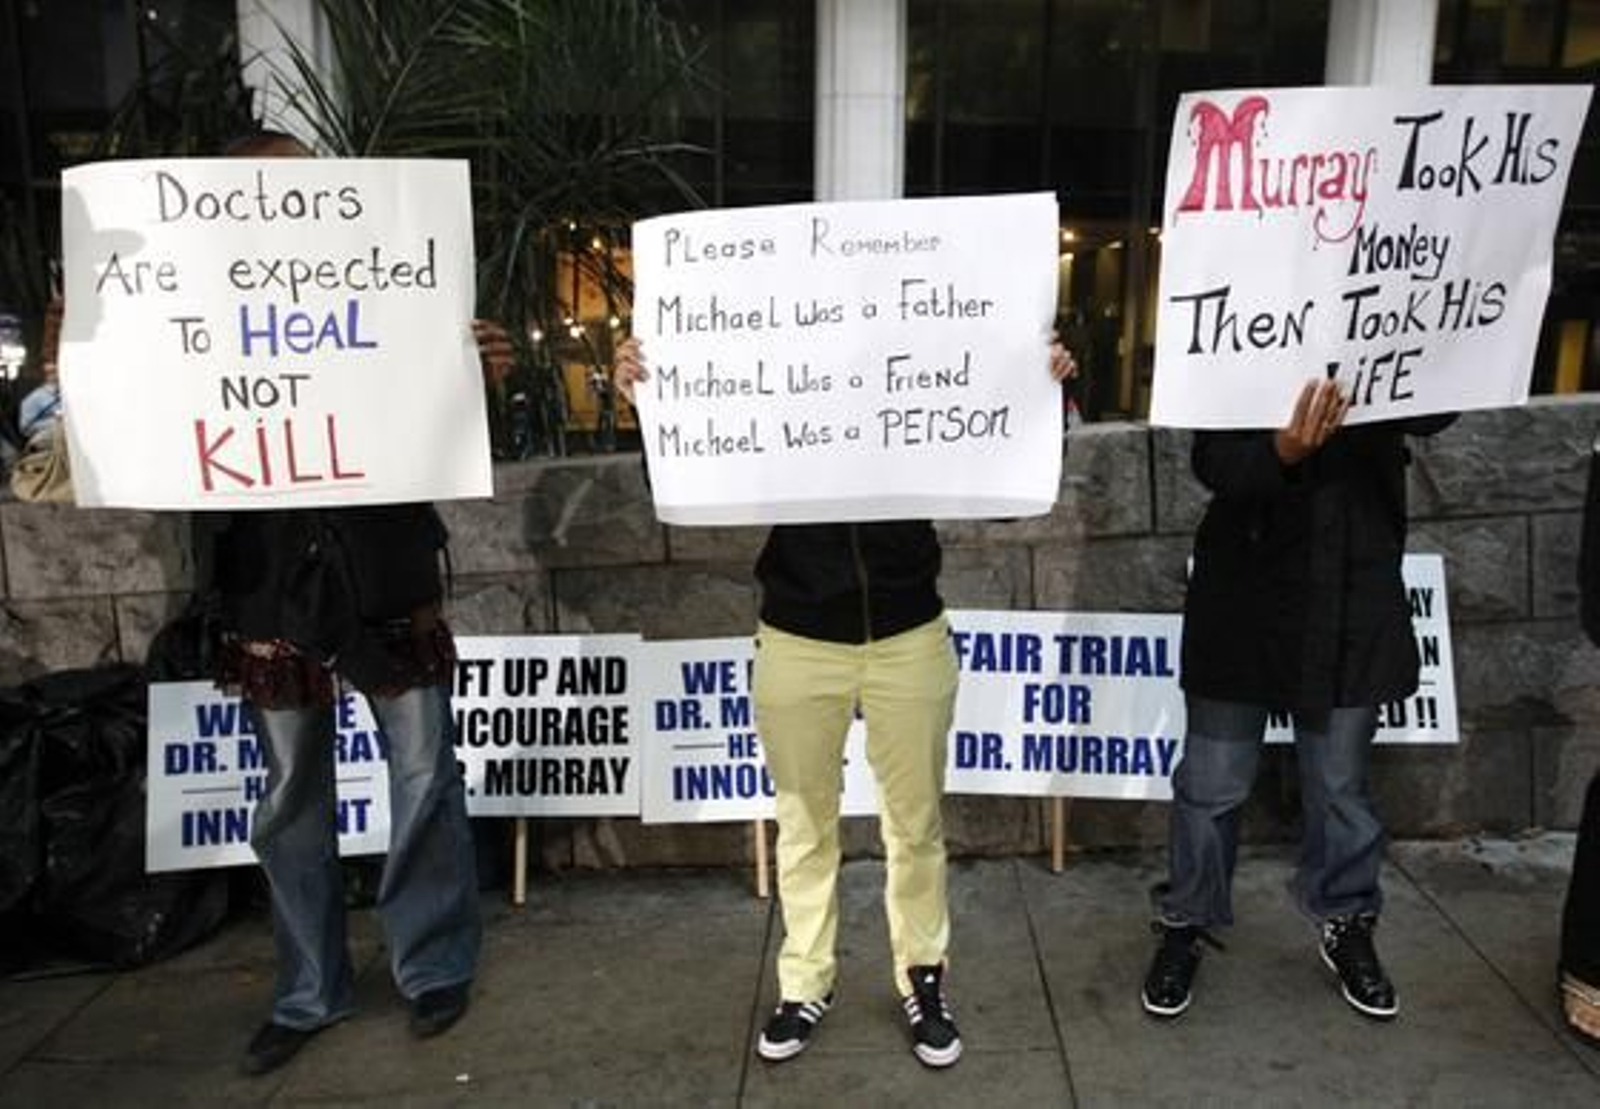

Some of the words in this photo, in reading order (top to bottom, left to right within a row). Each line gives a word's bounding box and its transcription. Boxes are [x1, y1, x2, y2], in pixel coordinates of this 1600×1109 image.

[1174, 94, 1378, 242] Murray
[1395, 110, 1489, 196] Took
[156, 170, 363, 223] Doctors
[811, 216, 943, 257] Remember
[97, 253, 179, 295] Are
[228, 239, 437, 302] expected
[863, 302, 878, 320] a
[900, 279, 994, 320] Father
[170, 317, 211, 354] To
[221, 374, 310, 410] NOT
[849, 374, 863, 389] a
[844, 425, 861, 441] a
[953, 632, 1042, 674] FAIR
[1054, 635, 1174, 677] TRIAL
[504, 658, 549, 697] UP
[556, 656, 627, 696] AND
[681, 661, 737, 695] WE
[656, 699, 711, 731] DR.
[1023, 684, 1092, 725] FOR
[455, 706, 629, 748] COURAGE
[164, 741, 228, 776] DR.
[955, 732, 1012, 771] DR.
[1021, 734, 1178, 777] MURRAY
[484, 756, 631, 797] MURRAY
